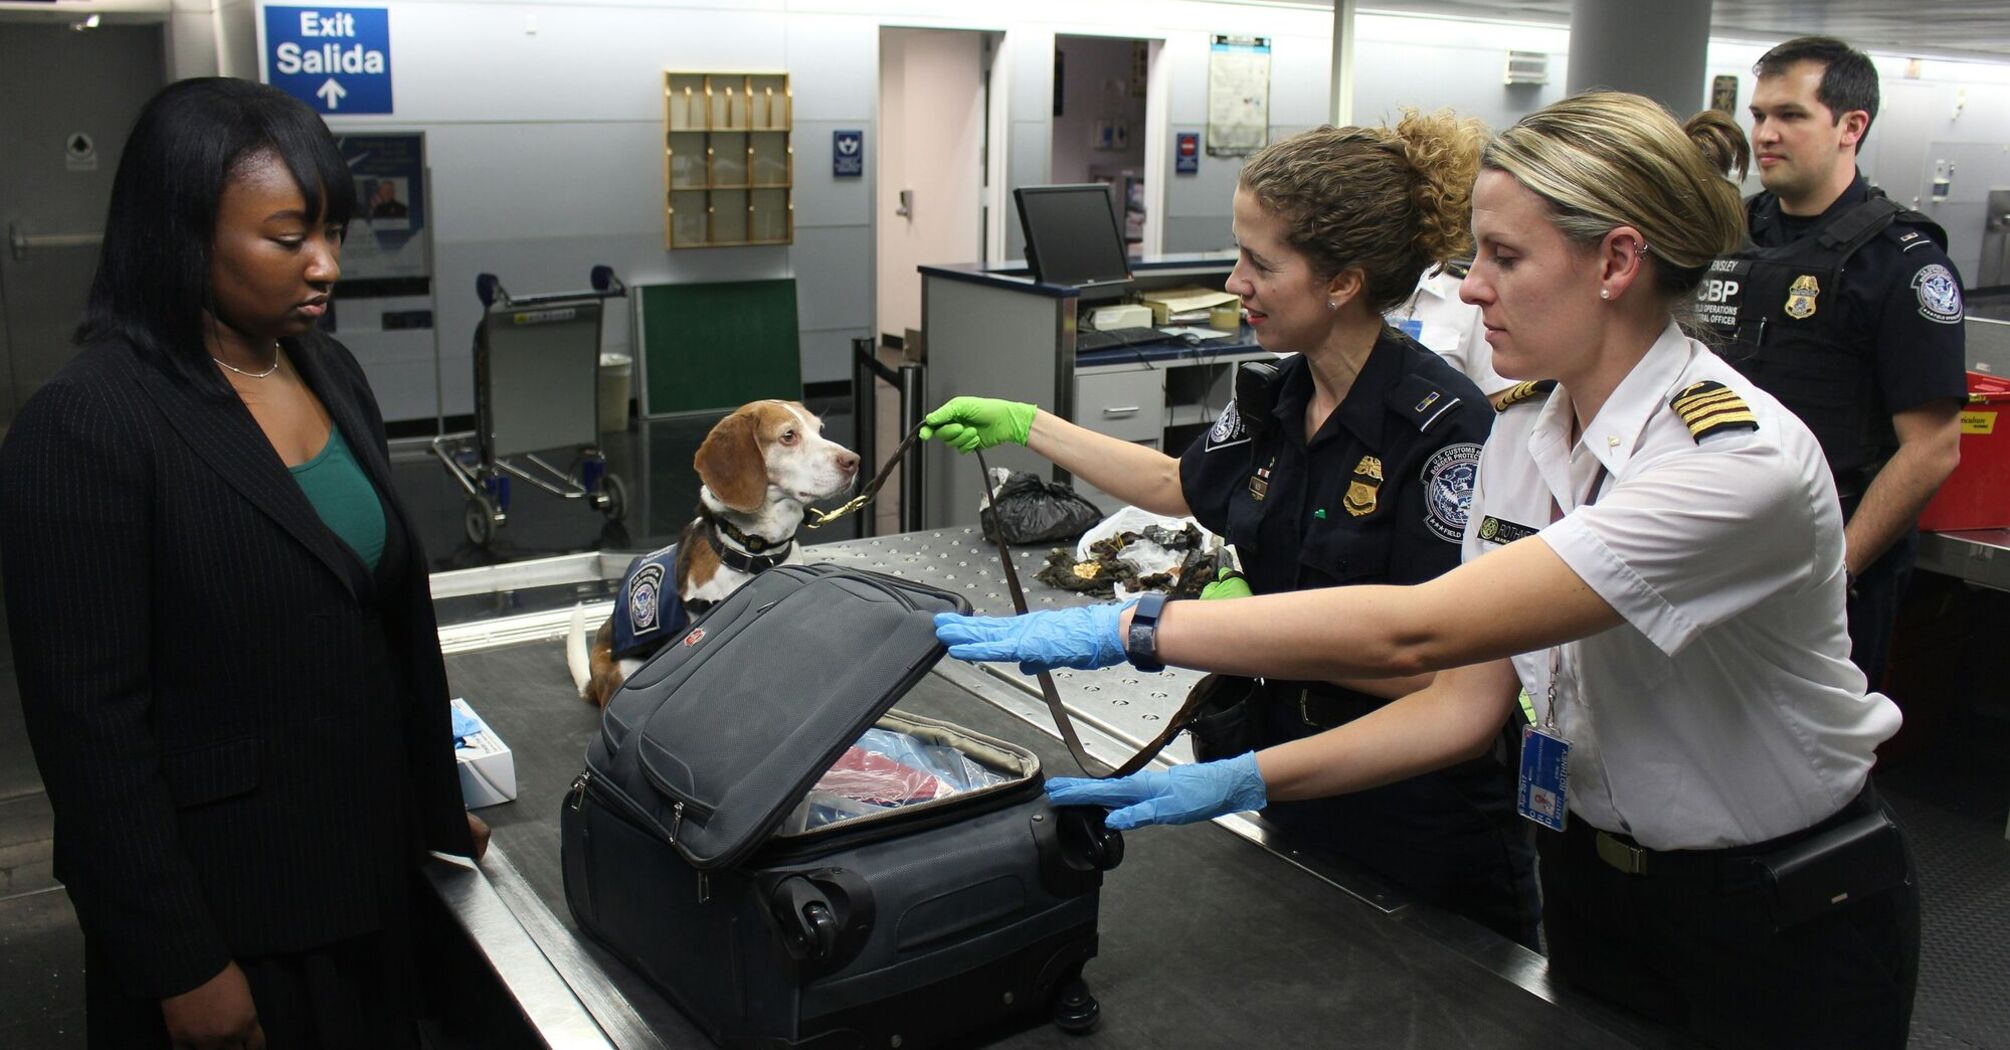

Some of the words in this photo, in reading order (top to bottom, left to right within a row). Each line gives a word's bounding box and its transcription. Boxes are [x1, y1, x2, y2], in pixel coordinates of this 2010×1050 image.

[300, 11, 355, 37] Exit
[276, 41, 384, 75] Salida
[1710, 259, 1739, 272] ENSLEY
[1703, 304, 1738, 316] OPERATIONS
[1710, 315, 1736, 326] OFFICER
[1445, 447, 1476, 457] CUSTOMS
[1430, 456, 1453, 475] BORDER
[1453, 453, 1479, 461] PROTEC
[1443, 528, 1461, 538] FIELD
